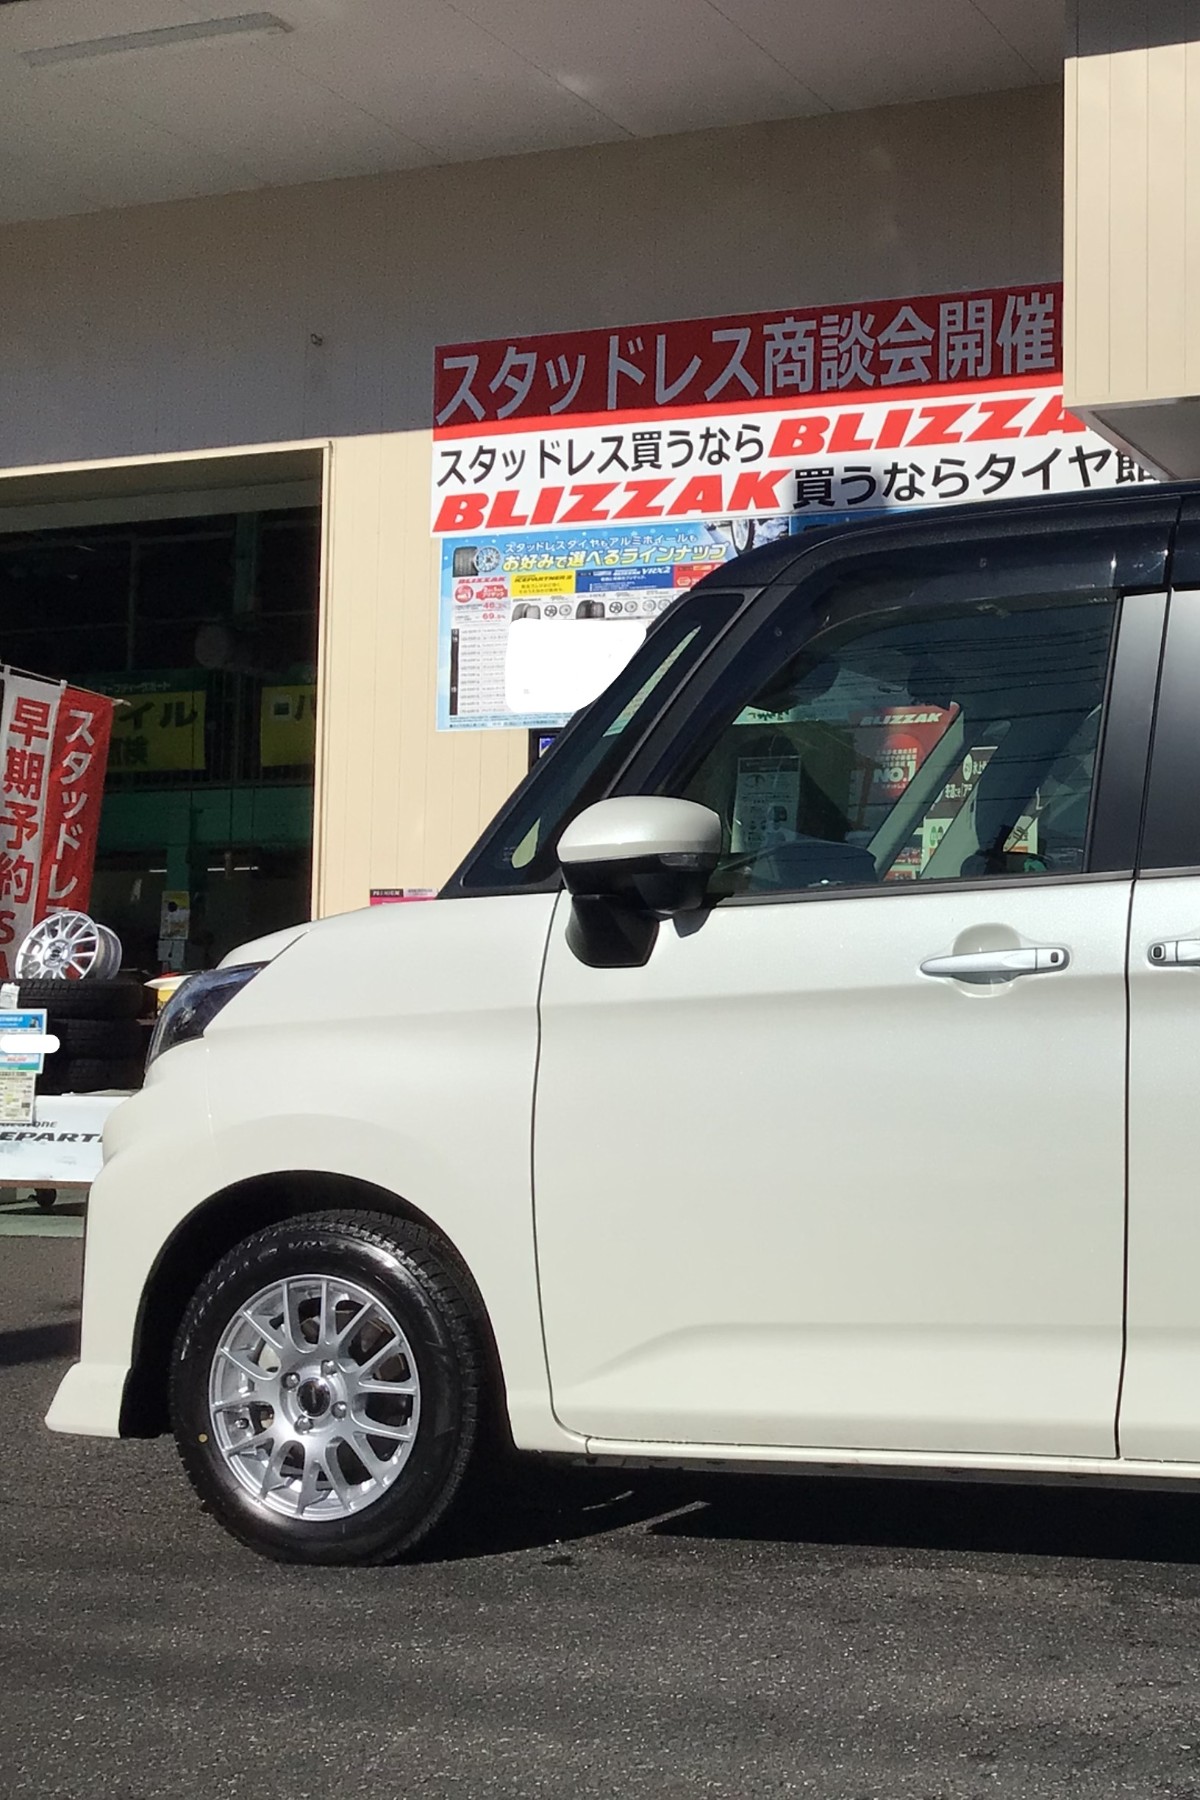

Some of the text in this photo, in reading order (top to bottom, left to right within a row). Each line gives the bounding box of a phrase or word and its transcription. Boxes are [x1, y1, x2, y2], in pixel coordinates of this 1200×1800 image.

[435, 291, 1055, 427] スタッドレス商談会開催
[437, 395, 1087, 488] スタッドレス買うなら BLIZZA
[433, 469, 793, 532] BLIZZAK
[502, 541, 730, 573] お好みで選べるラインナップ
[859, 712, 944, 727] BLIZZAK
[46, 708, 95, 913] スタッドレ
[0, 1131, 103, 1143] EPART
